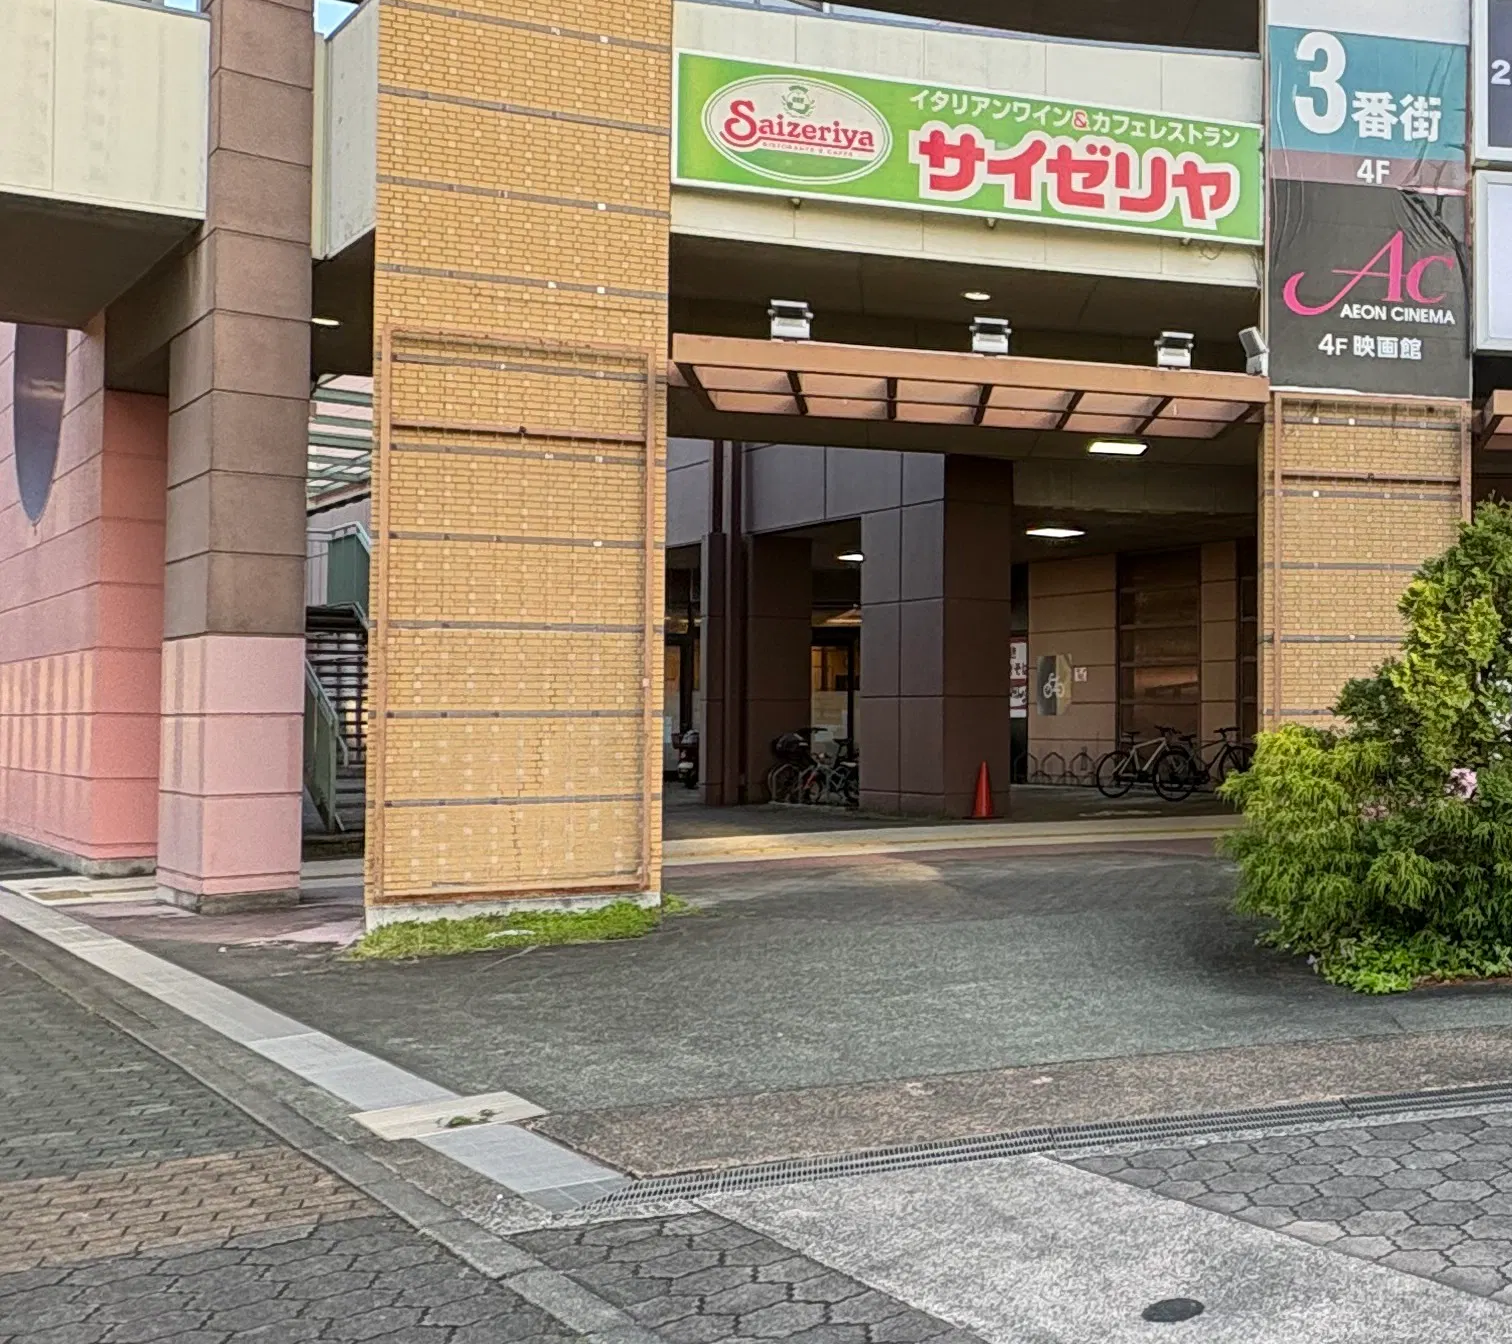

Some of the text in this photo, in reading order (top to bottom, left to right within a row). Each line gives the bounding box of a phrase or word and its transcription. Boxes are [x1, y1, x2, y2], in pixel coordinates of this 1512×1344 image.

[1293, 30, 1442, 143] 3番街
[719, 99, 875, 153] Saizeriya
[909, 89, 1241, 149] イタリアンワイン&カフェレストラン
[913, 124, 1236, 225] サイゼリヤ
[1356, 159, 1391, 185] 4F
[1340, 303, 1456, 325] AEON CINEMA
[1318, 333, 1422, 360] 4F 映画館
